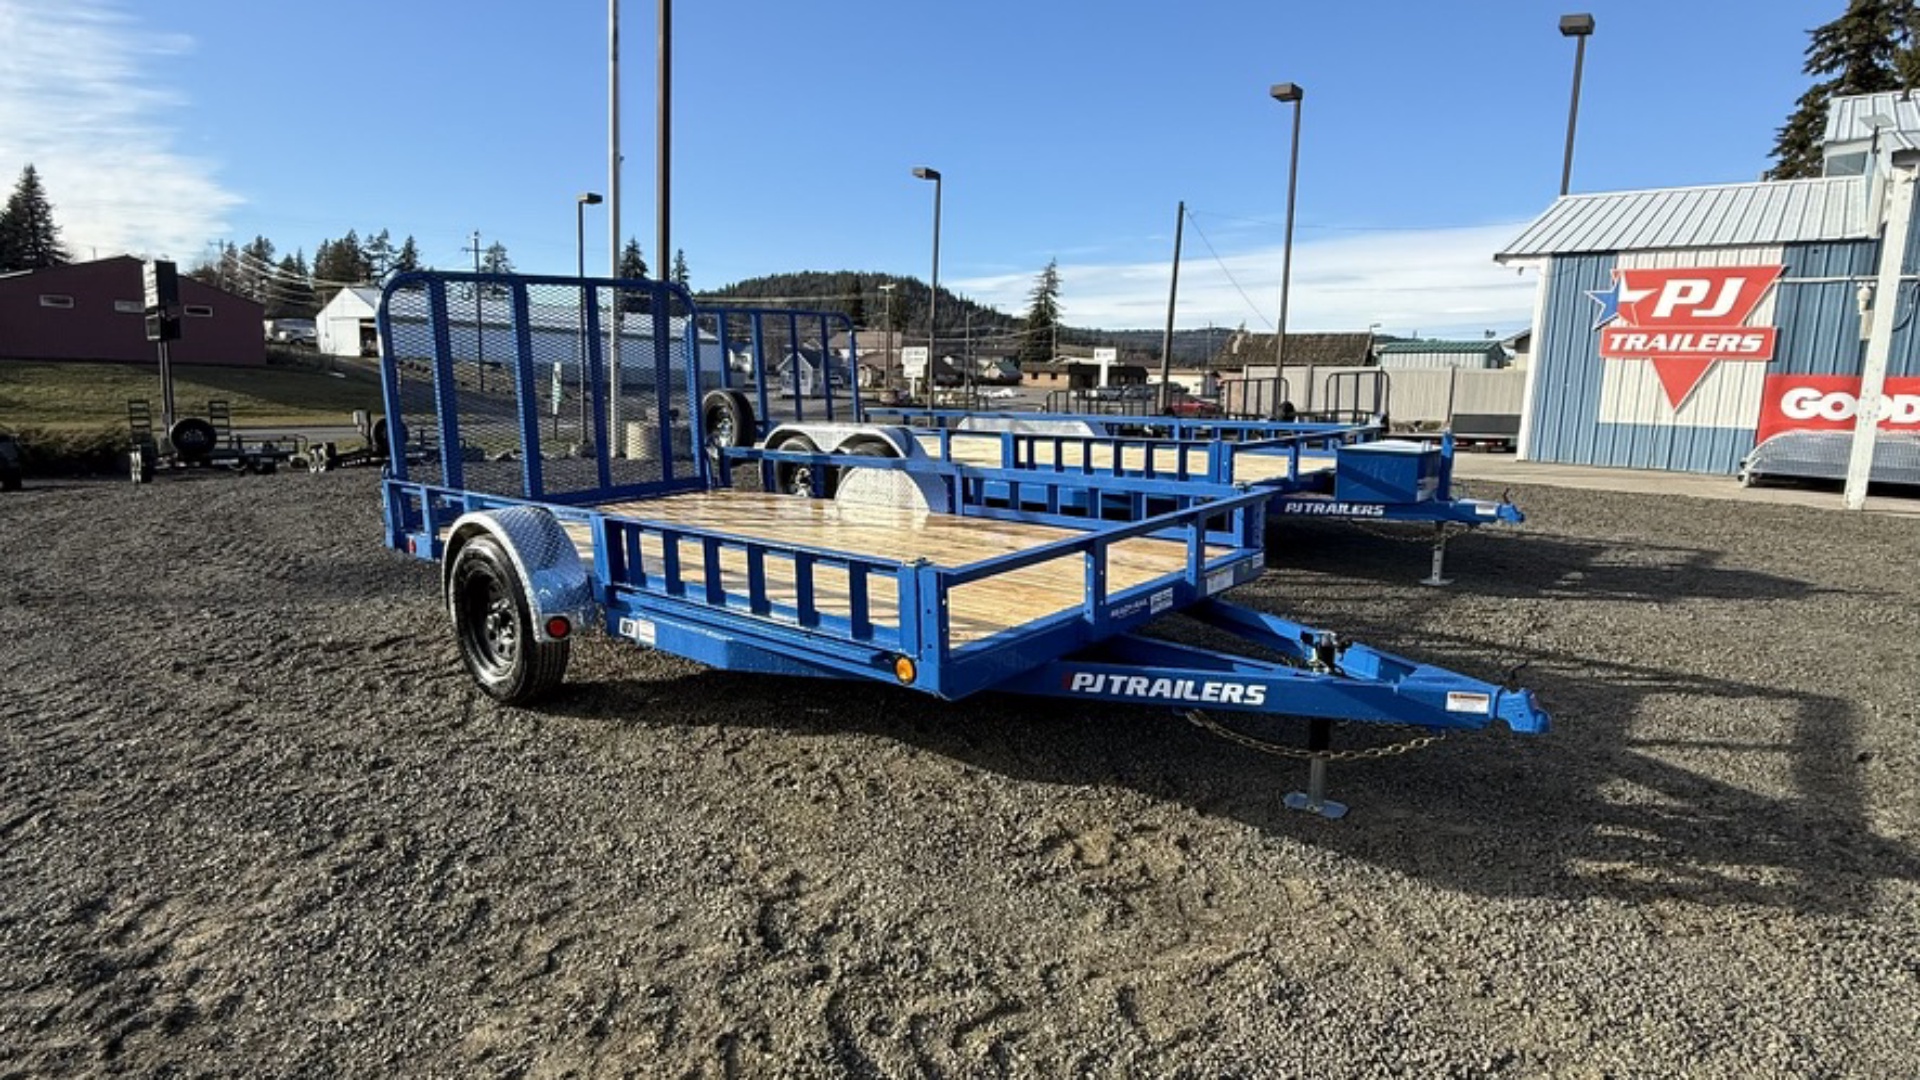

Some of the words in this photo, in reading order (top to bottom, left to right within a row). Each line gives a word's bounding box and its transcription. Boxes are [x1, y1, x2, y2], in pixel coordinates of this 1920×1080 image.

[1650, 276, 1747, 318] PJ
[1608, 333, 1765, 352] TRAILERS
[1303, 502, 1386, 516] TRAILERS
[1070, 672, 1106, 693] PJ
[1108, 675, 1267, 706] TRAILERS
